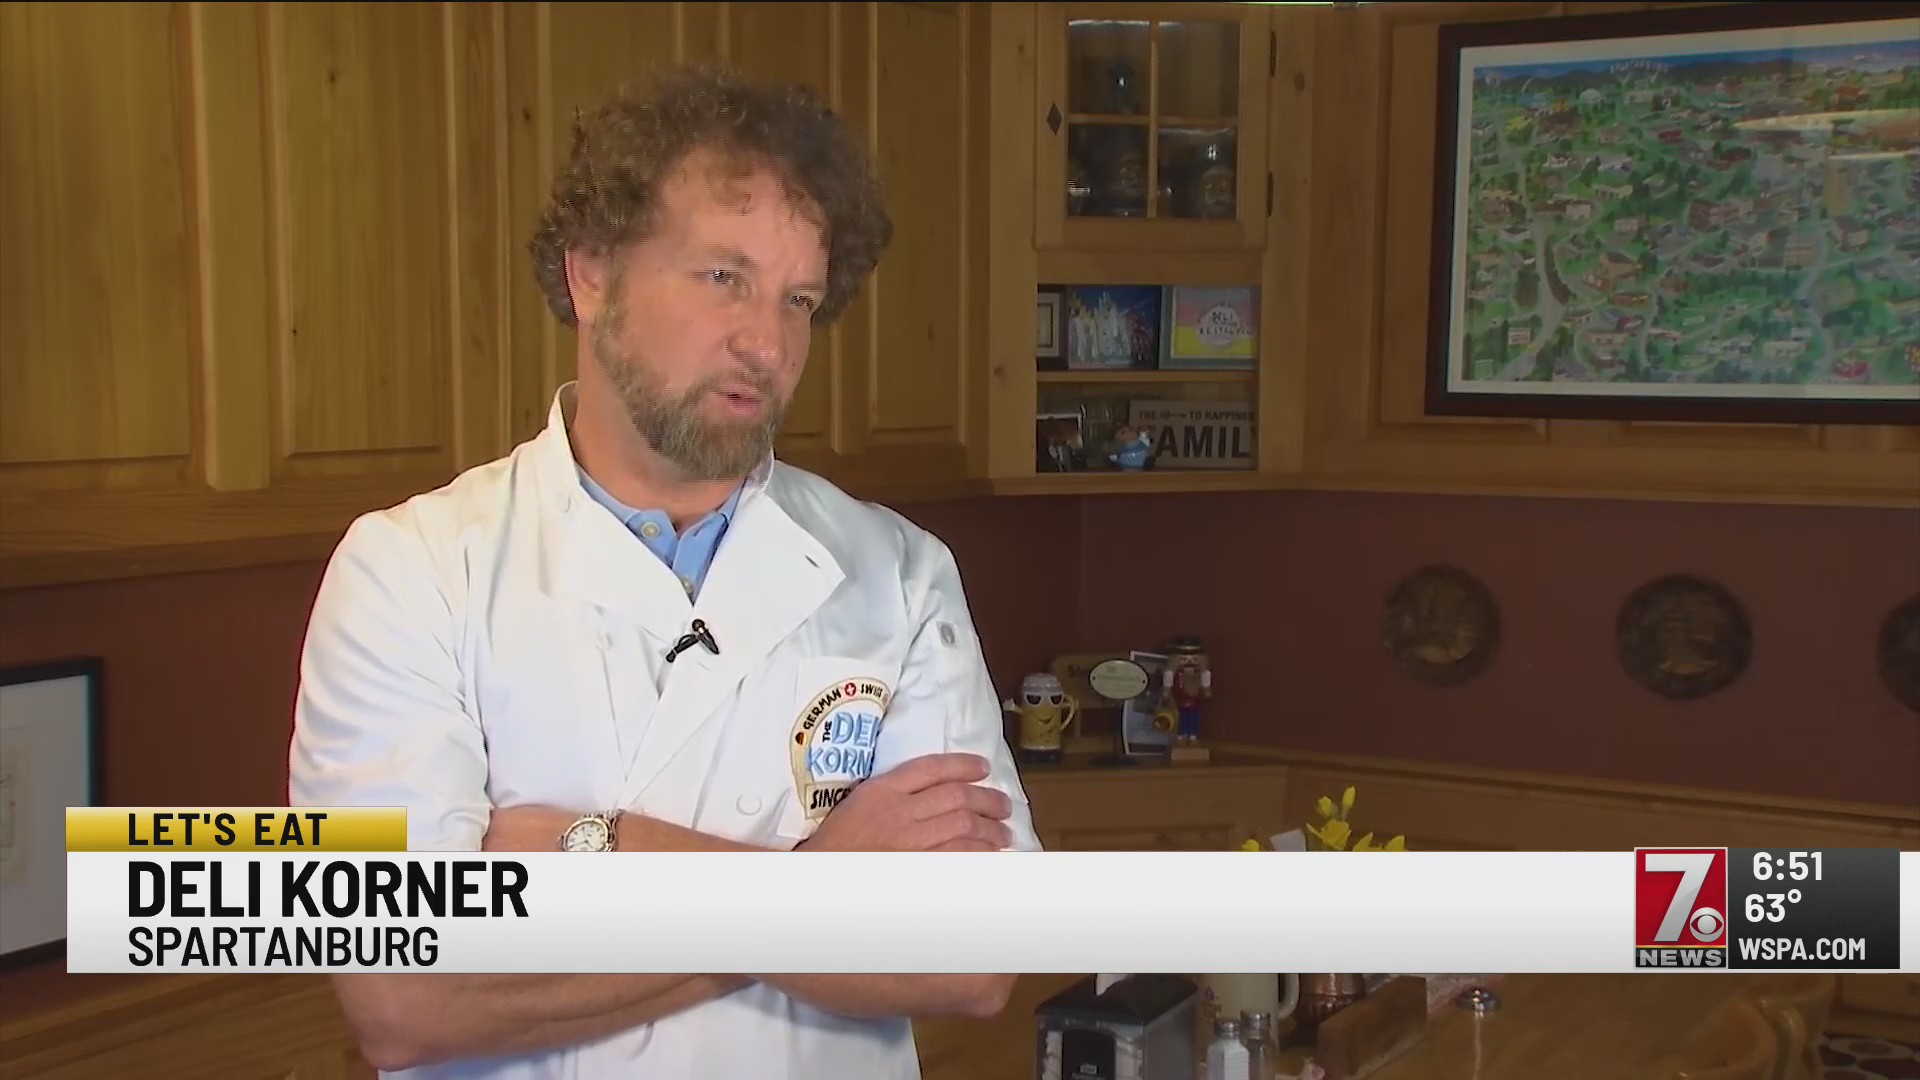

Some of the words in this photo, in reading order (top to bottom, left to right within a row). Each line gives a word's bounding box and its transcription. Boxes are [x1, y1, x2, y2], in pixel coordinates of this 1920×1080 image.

[1138, 411, 1156, 420] THE
[1189, 411, 1202, 420] TO
[1204, 411, 1256, 422] HAPPINES
[803, 688, 842, 731] GERMAN
[860, 683, 884, 699] SWISS
[822, 720, 833, 743] THE
[831, 711, 880, 748] DEL
[806, 747, 872, 778] KORN
